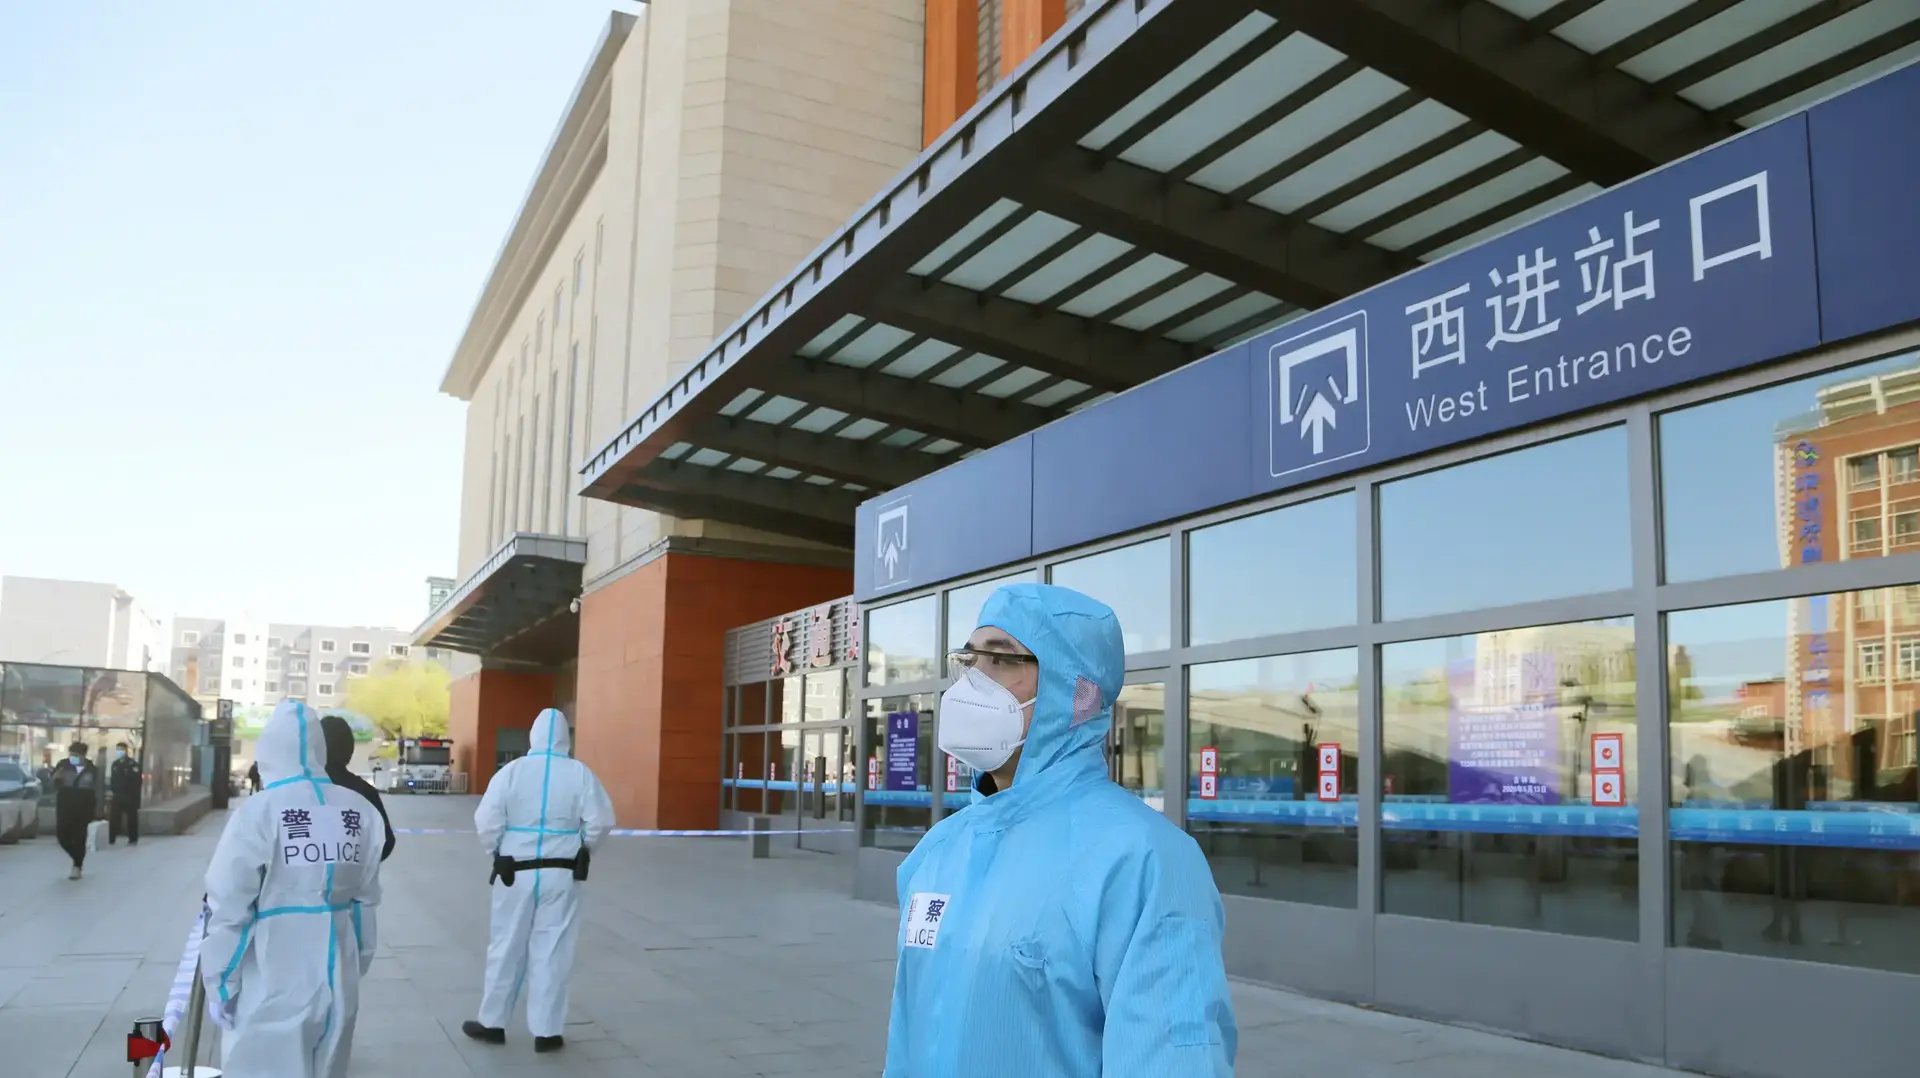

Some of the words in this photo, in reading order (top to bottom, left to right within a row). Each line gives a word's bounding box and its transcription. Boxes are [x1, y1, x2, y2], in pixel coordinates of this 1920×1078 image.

[1404, 169, 1773, 380] 西进站口
[1405, 380, 1488, 431] West
[1508, 325, 1692, 403] Entrance
[281, 808, 362, 840] 警察
[284, 842, 362, 865] POLICE
[904, 928, 936, 946] LICE
